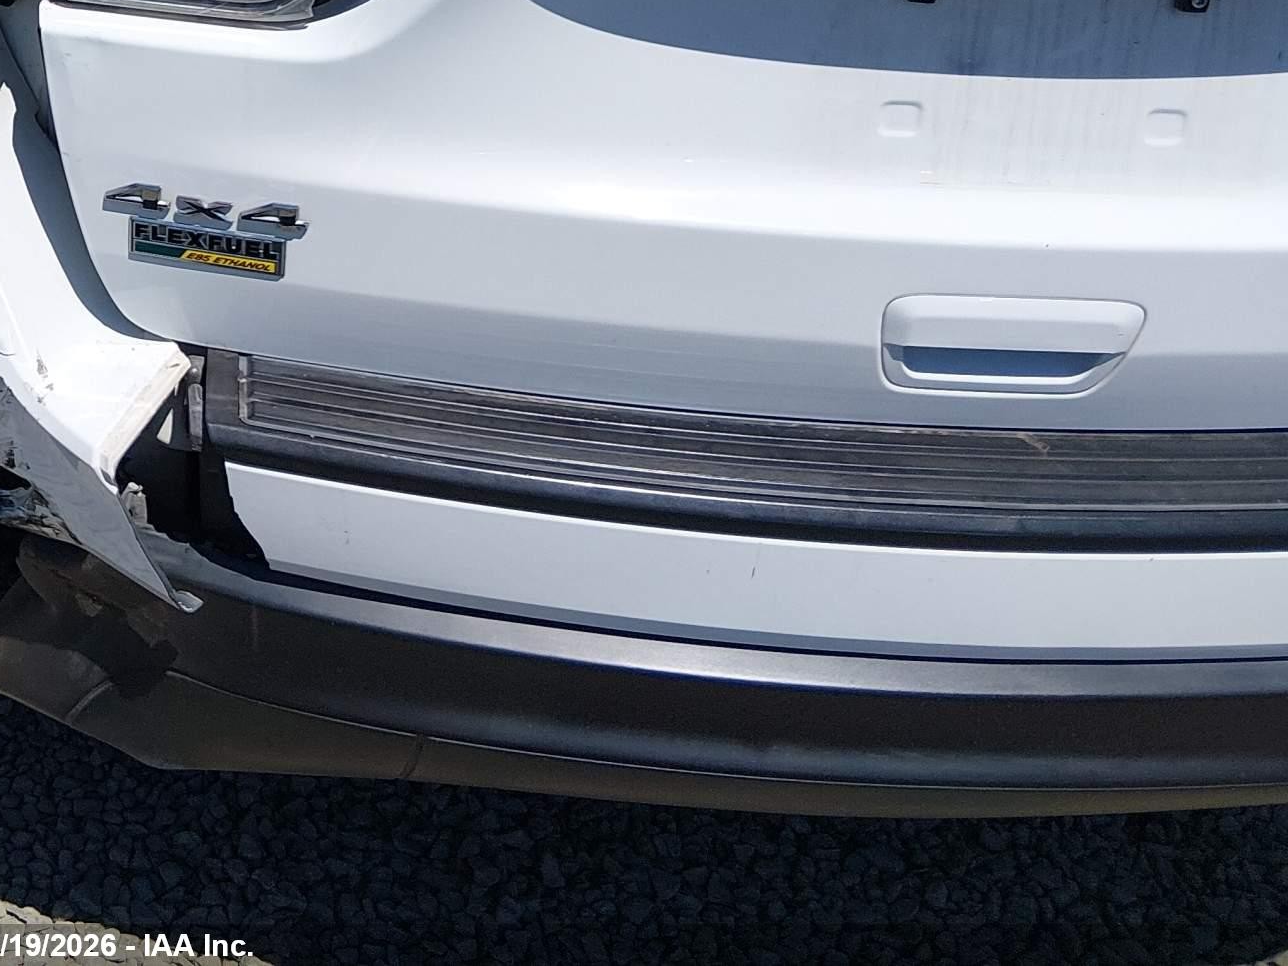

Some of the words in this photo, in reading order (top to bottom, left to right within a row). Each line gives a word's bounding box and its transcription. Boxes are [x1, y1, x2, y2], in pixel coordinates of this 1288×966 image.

[133, 221, 281, 261] FLEXFUEL
[185, 251, 212, 263] E85
[213, 256, 274, 273] ETHANOL
